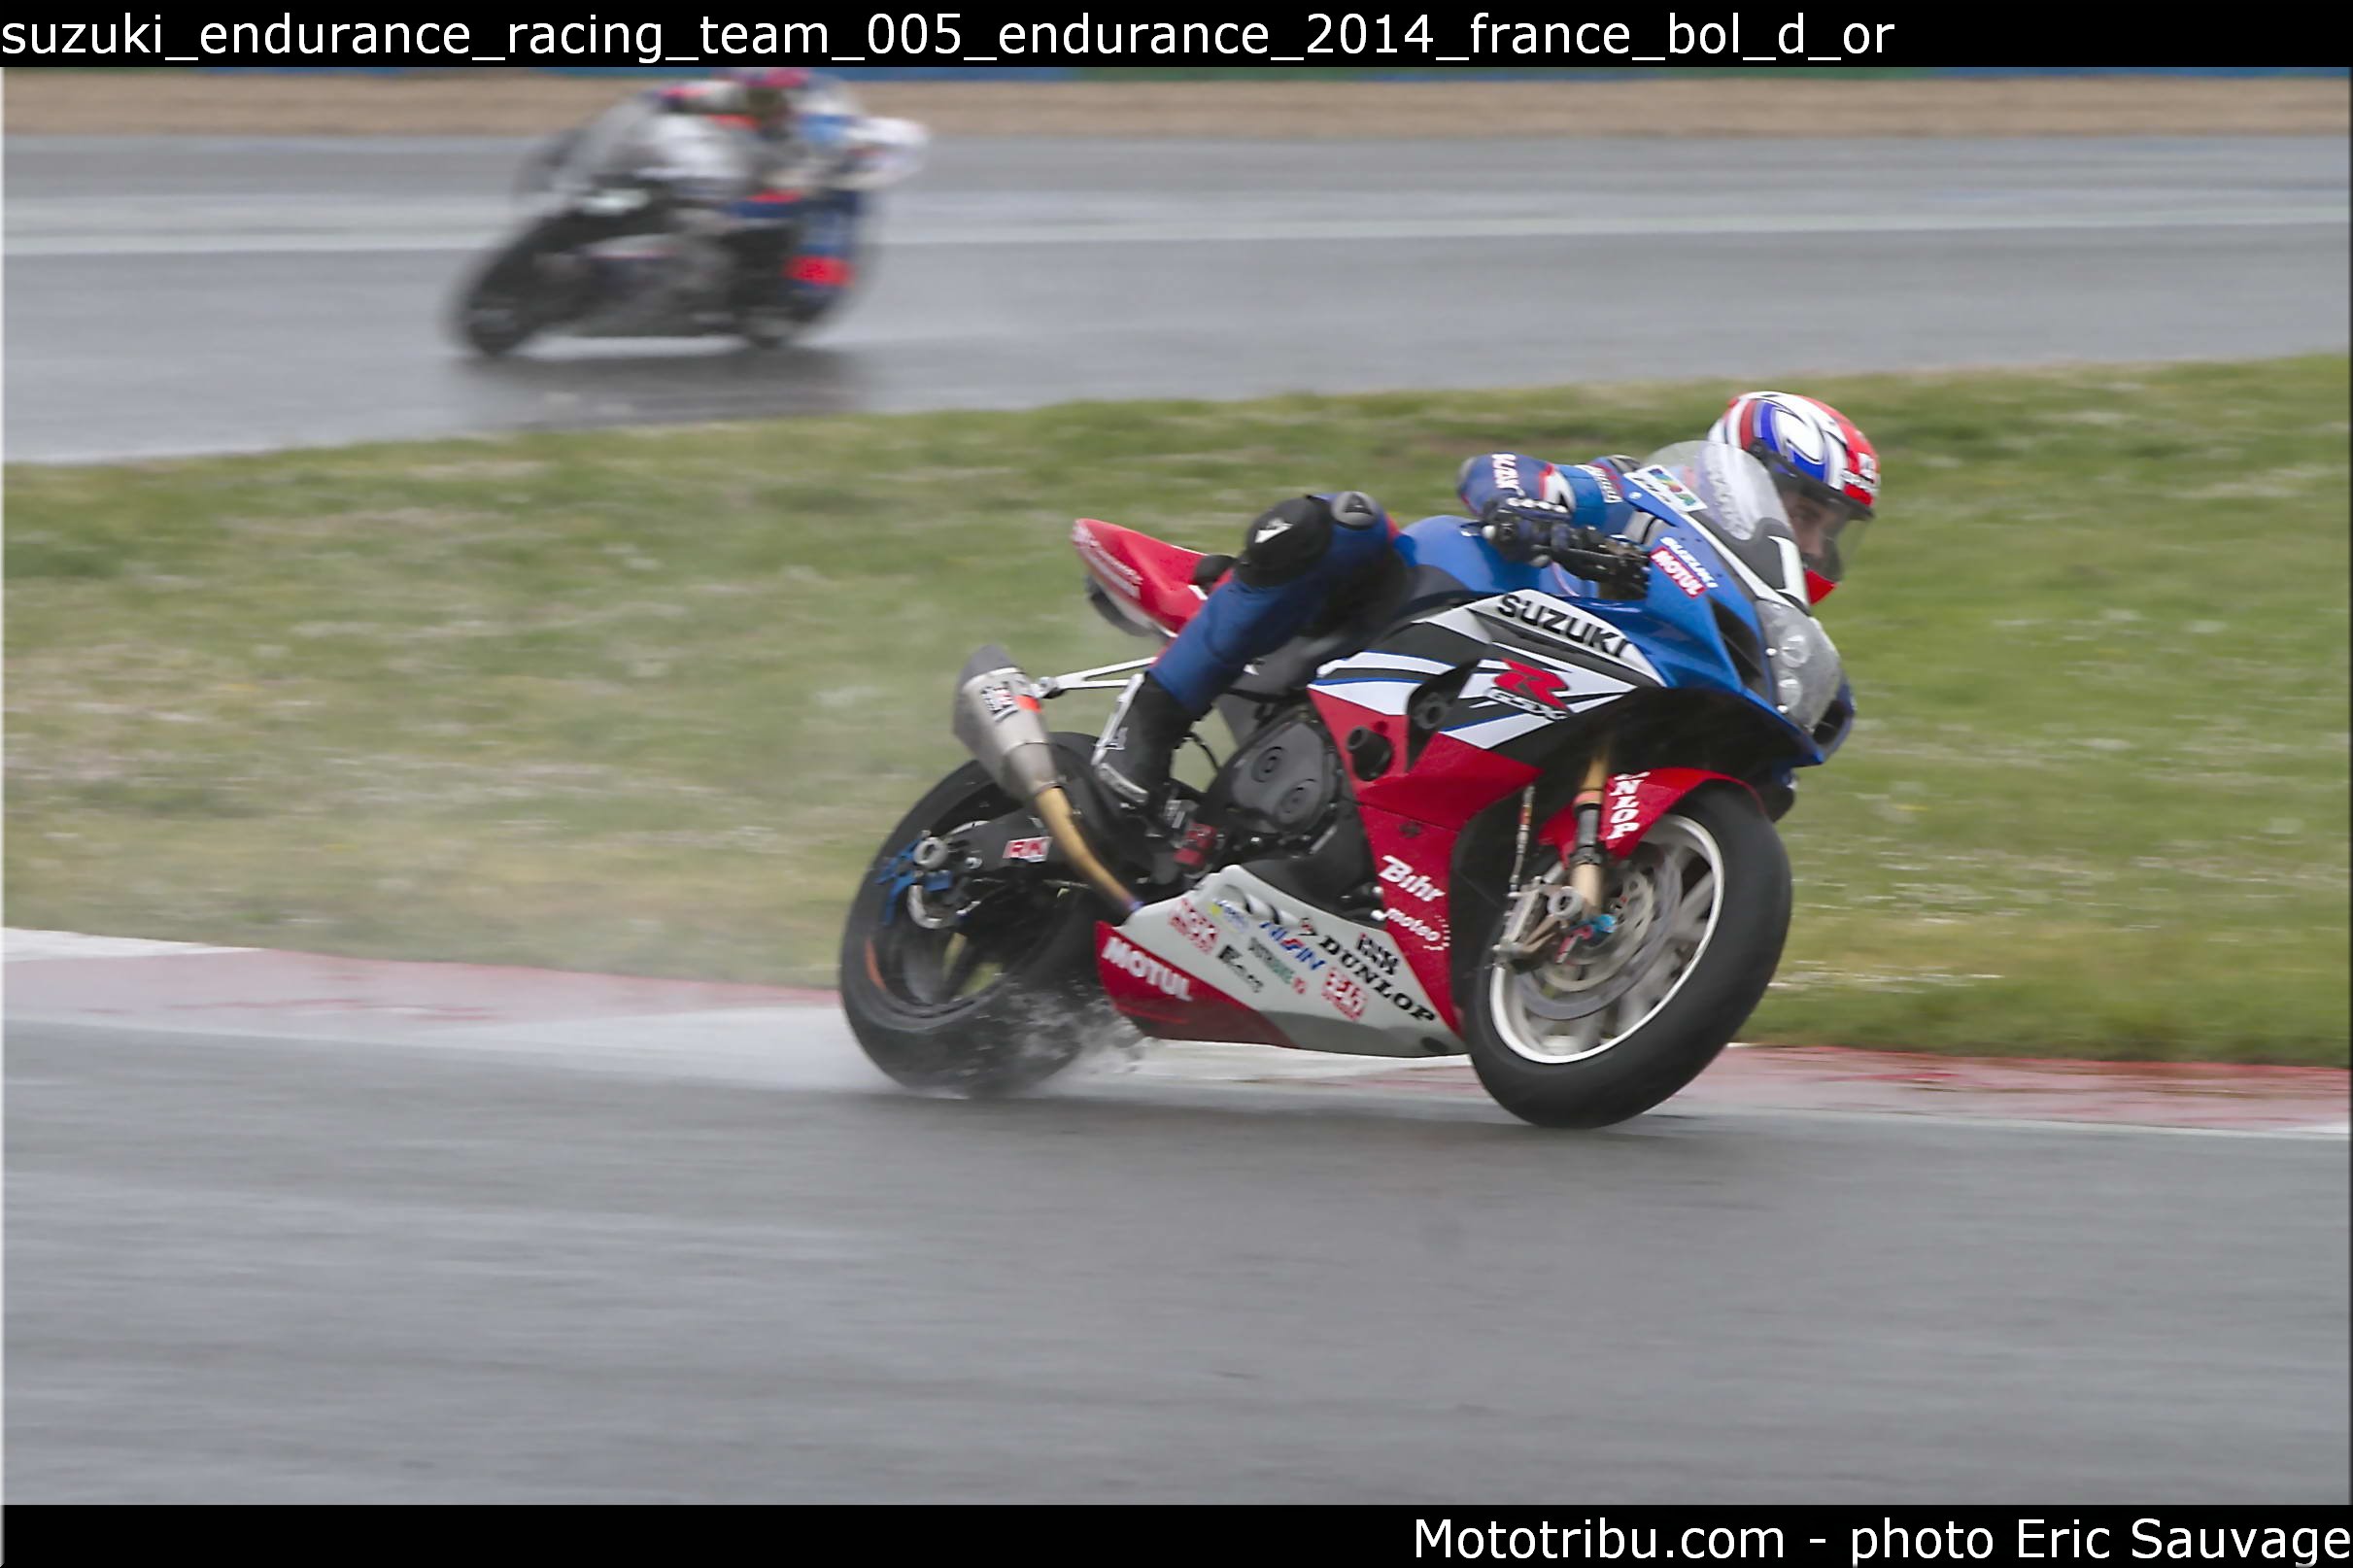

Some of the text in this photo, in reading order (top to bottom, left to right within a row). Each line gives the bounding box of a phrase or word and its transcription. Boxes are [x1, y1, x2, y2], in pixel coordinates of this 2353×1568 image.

[1651, 550, 1700, 596] MOTUL
[1660, 536, 1719, 588] SUZUKI
[1497, 594, 1627, 658] SUZUKI
[1378, 855, 1446, 902] Bihr
[1101, 937, 1193, 1003] MOTUL
[1318, 935, 1436, 1021] DUNLOP
